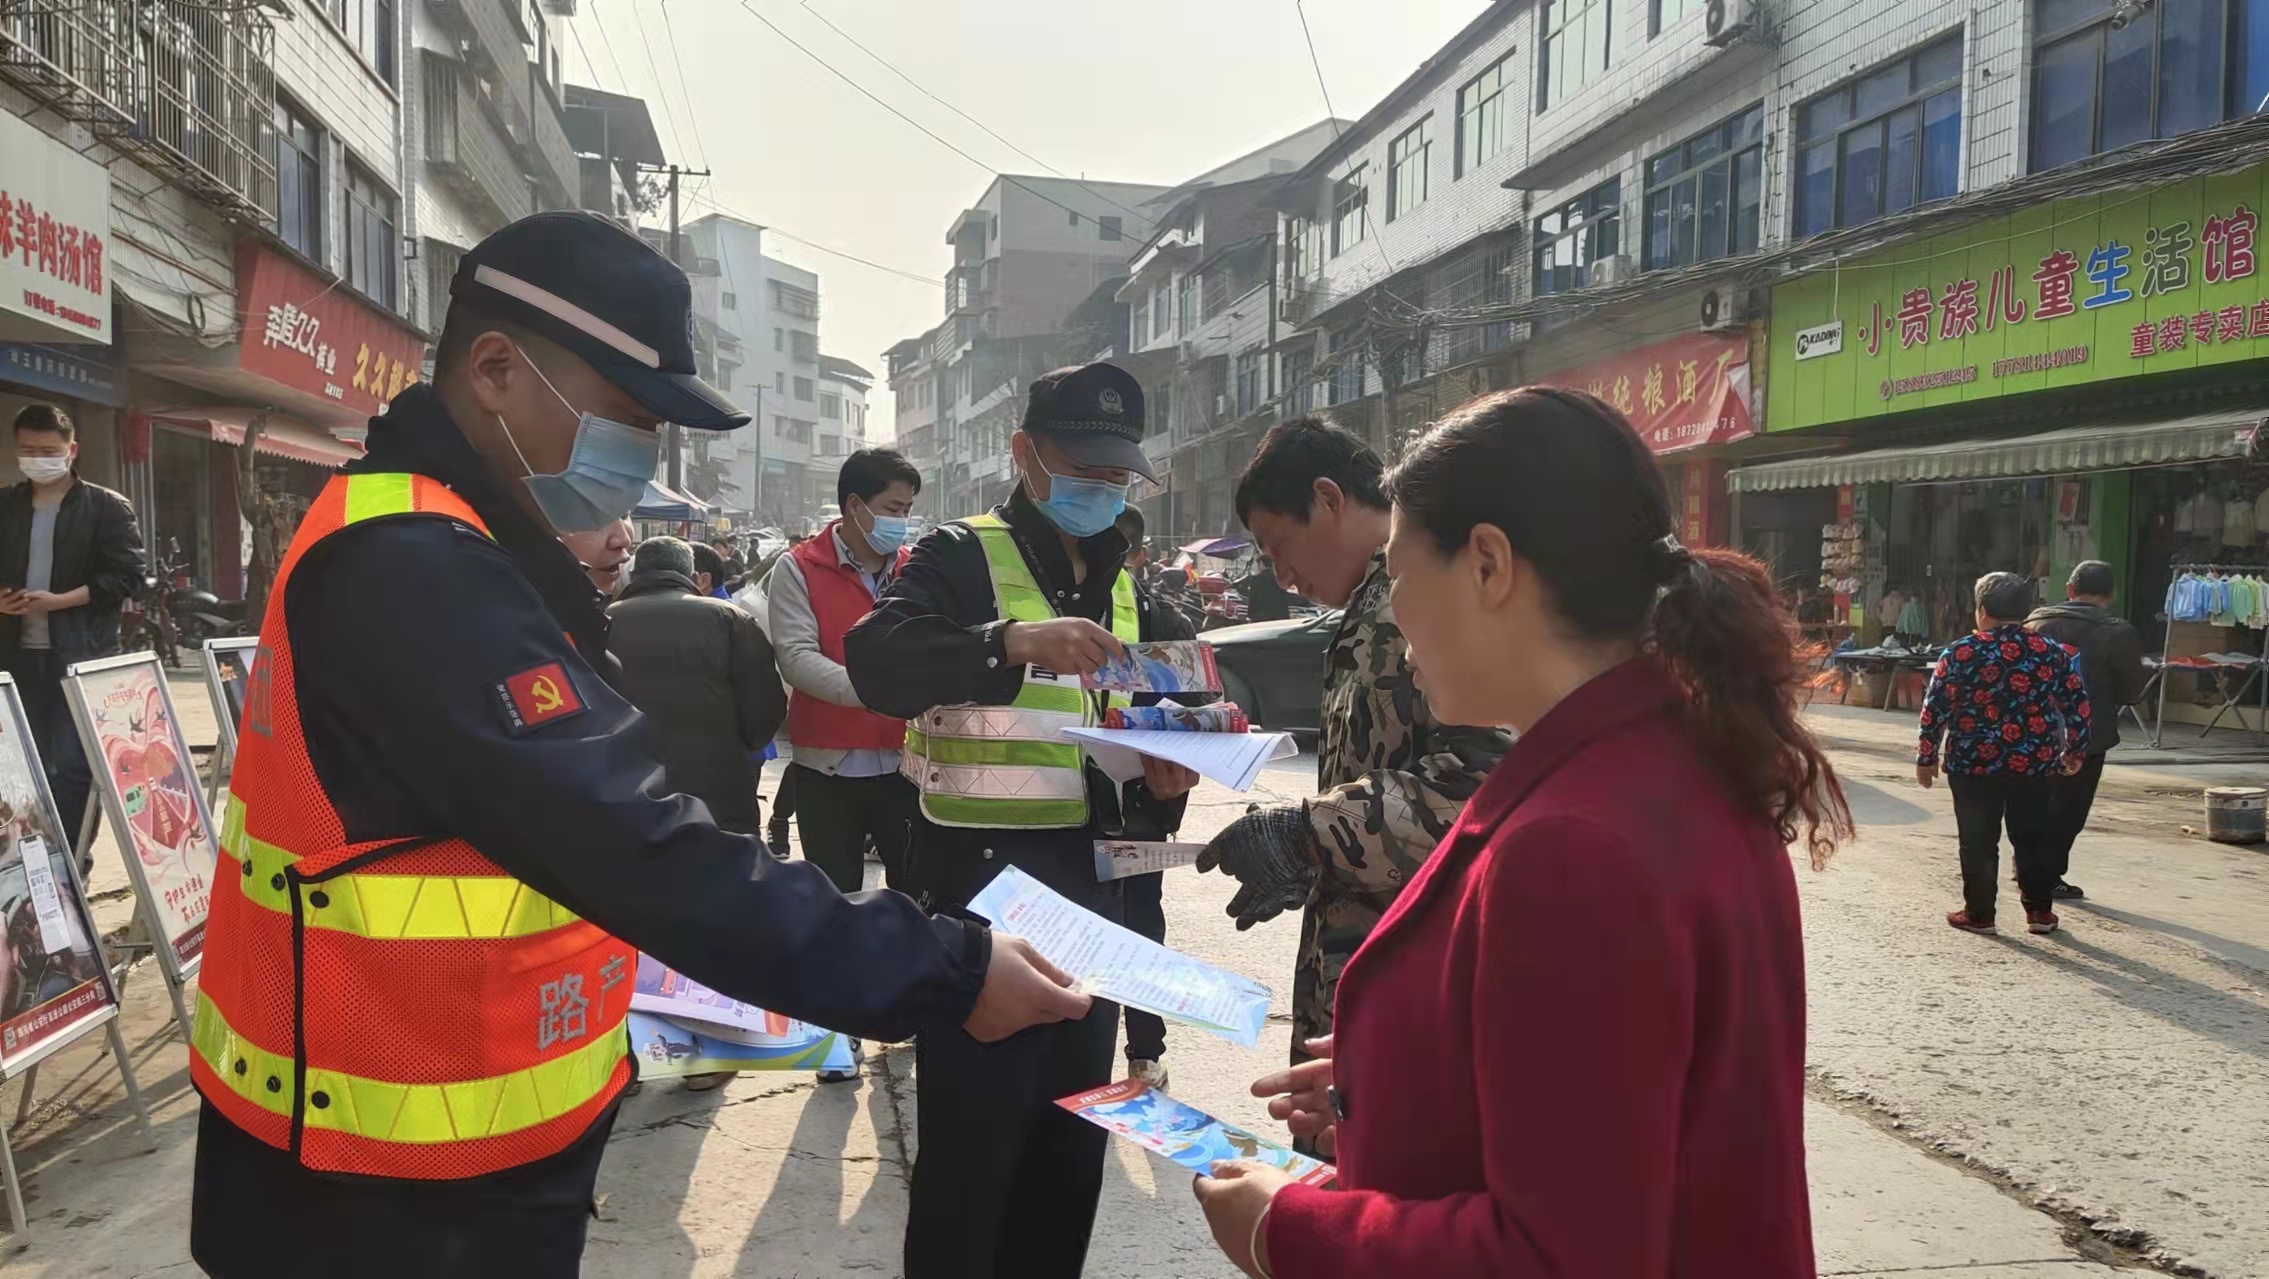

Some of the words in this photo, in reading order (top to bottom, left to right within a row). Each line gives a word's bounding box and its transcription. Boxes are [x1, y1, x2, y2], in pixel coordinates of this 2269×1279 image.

[1857, 204, 2258, 356] 小贵族儿童生活馆
[2130, 297, 2269, 358] 童装专卖店
[537, 954, 627, 1052] 路产
